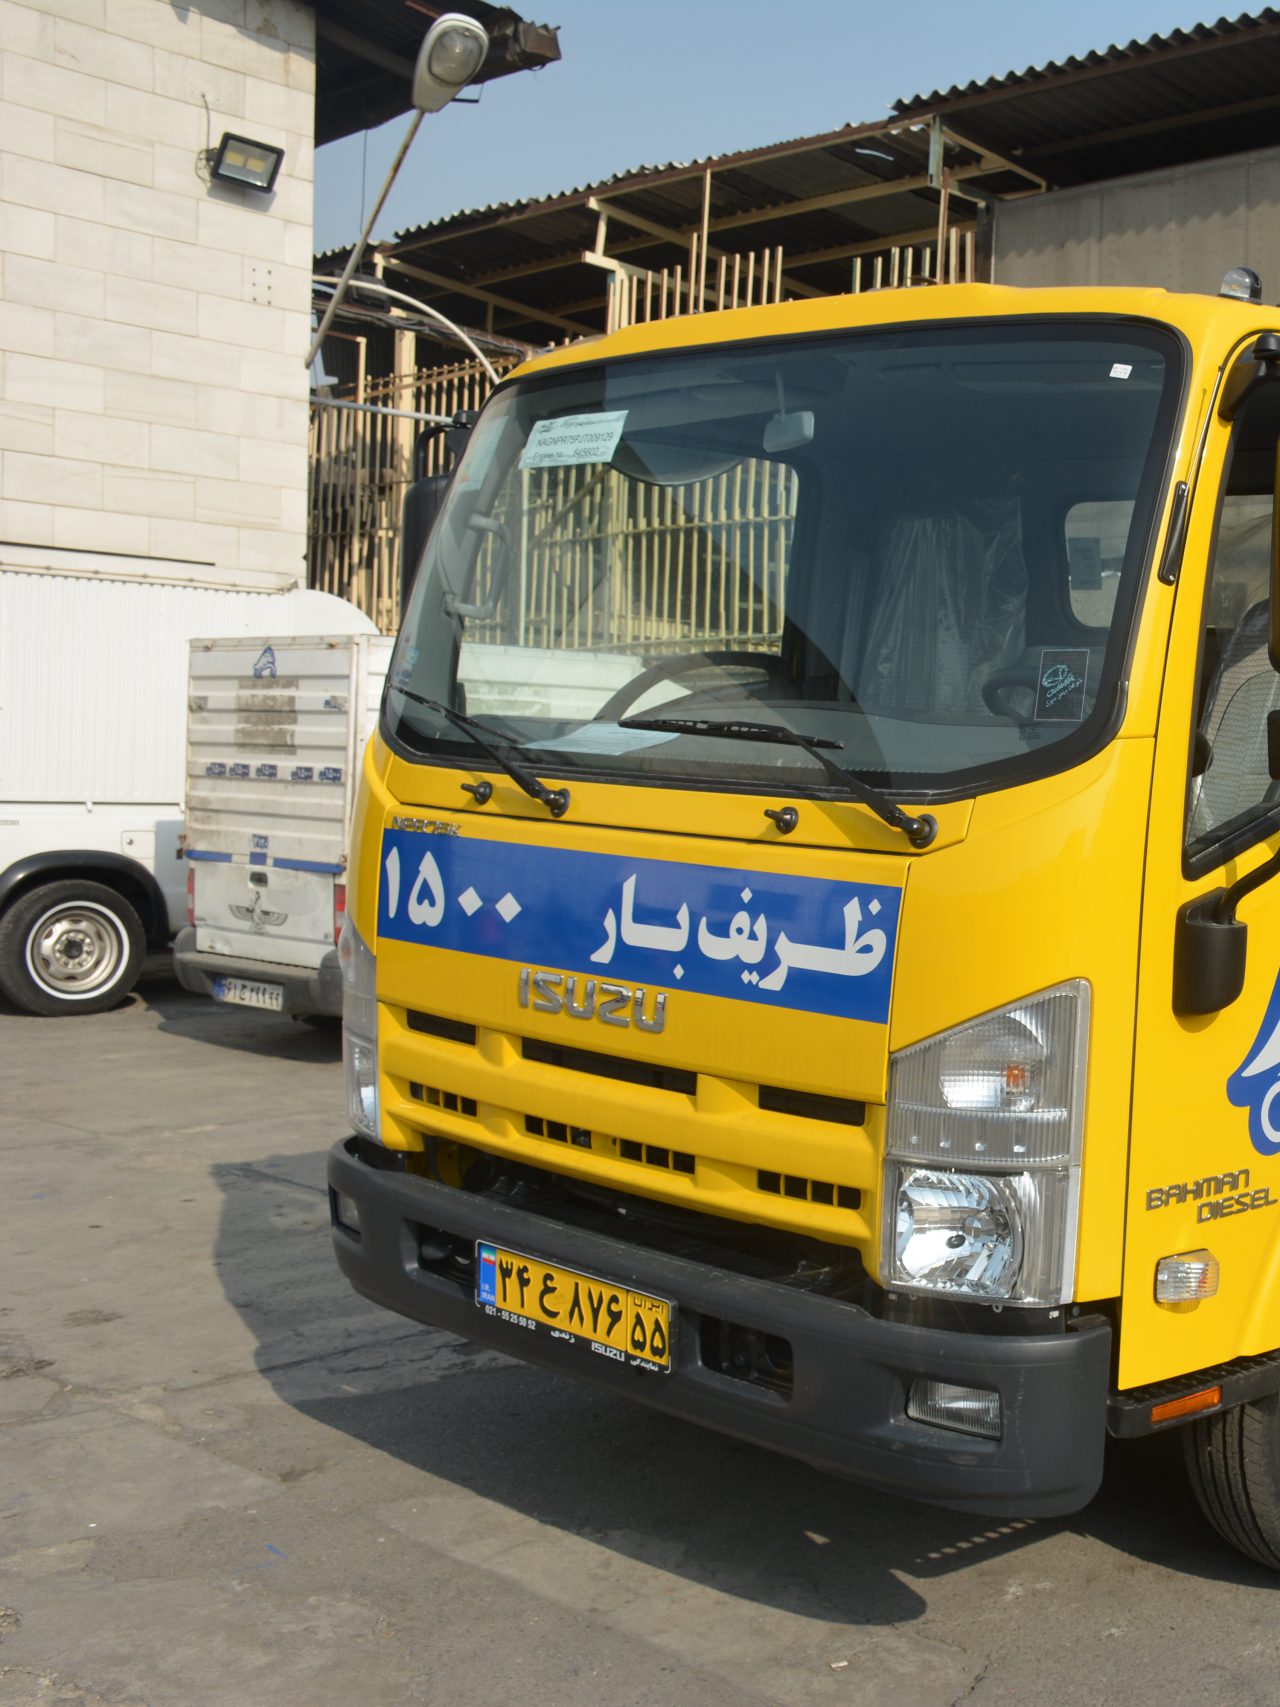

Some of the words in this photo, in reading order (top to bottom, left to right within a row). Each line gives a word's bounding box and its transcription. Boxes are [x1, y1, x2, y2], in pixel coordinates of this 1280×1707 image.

[384, 846, 523, 928] ۱۵۰۰
[518, 968, 669, 1033] ISUZU
[1145, 1168, 1250, 1212] BAHMAN
[1196, 1186, 1279, 1224] DIESEL
[591, 1341, 625, 1362] ISUZU
[630, 1311, 667, 1359] ۵۵
